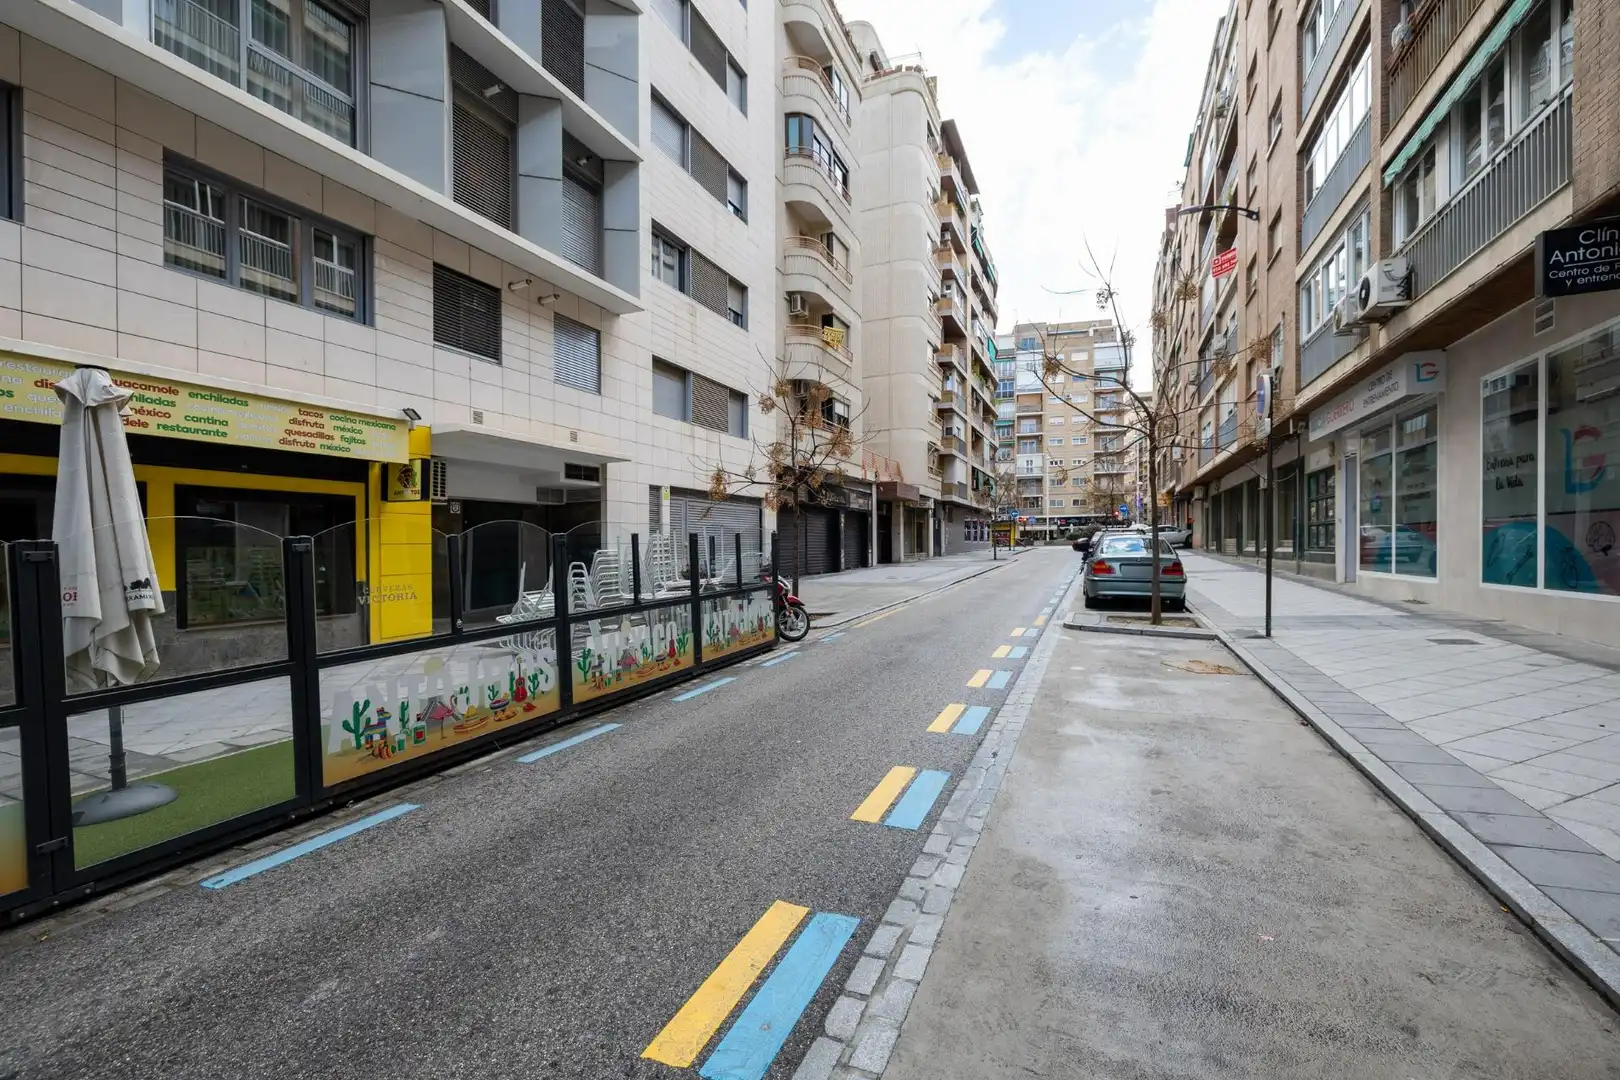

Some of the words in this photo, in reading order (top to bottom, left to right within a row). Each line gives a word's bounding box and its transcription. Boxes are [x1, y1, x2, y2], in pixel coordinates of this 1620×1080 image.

[1579, 226, 1619, 244] Clín
[1549, 266, 1590, 279] Centro
[1594, 264, 1610, 274] de
[1566, 279, 1573, 288] y
[131, 393, 177, 408] hiladas
[289, 417, 325, 430] disfruta
[333, 424, 364, 435] méxico
[188, 391, 249, 407] enchiladas
[298, 408, 324, 419] tacos
[329, 412, 358, 424] cocina
[358, 419, 397, 431] mexicana
[123, 417, 149, 429] dele
[157, 421, 228, 438] restaurante
[279, 437, 316, 449] disfruta
[320, 442, 351, 453] méxico
[184, 414, 229, 427] cantina
[284, 428, 335, 441] quesadillas
[340, 434, 367, 445] fajitas
[357, 592, 418, 605] VICTORIA
